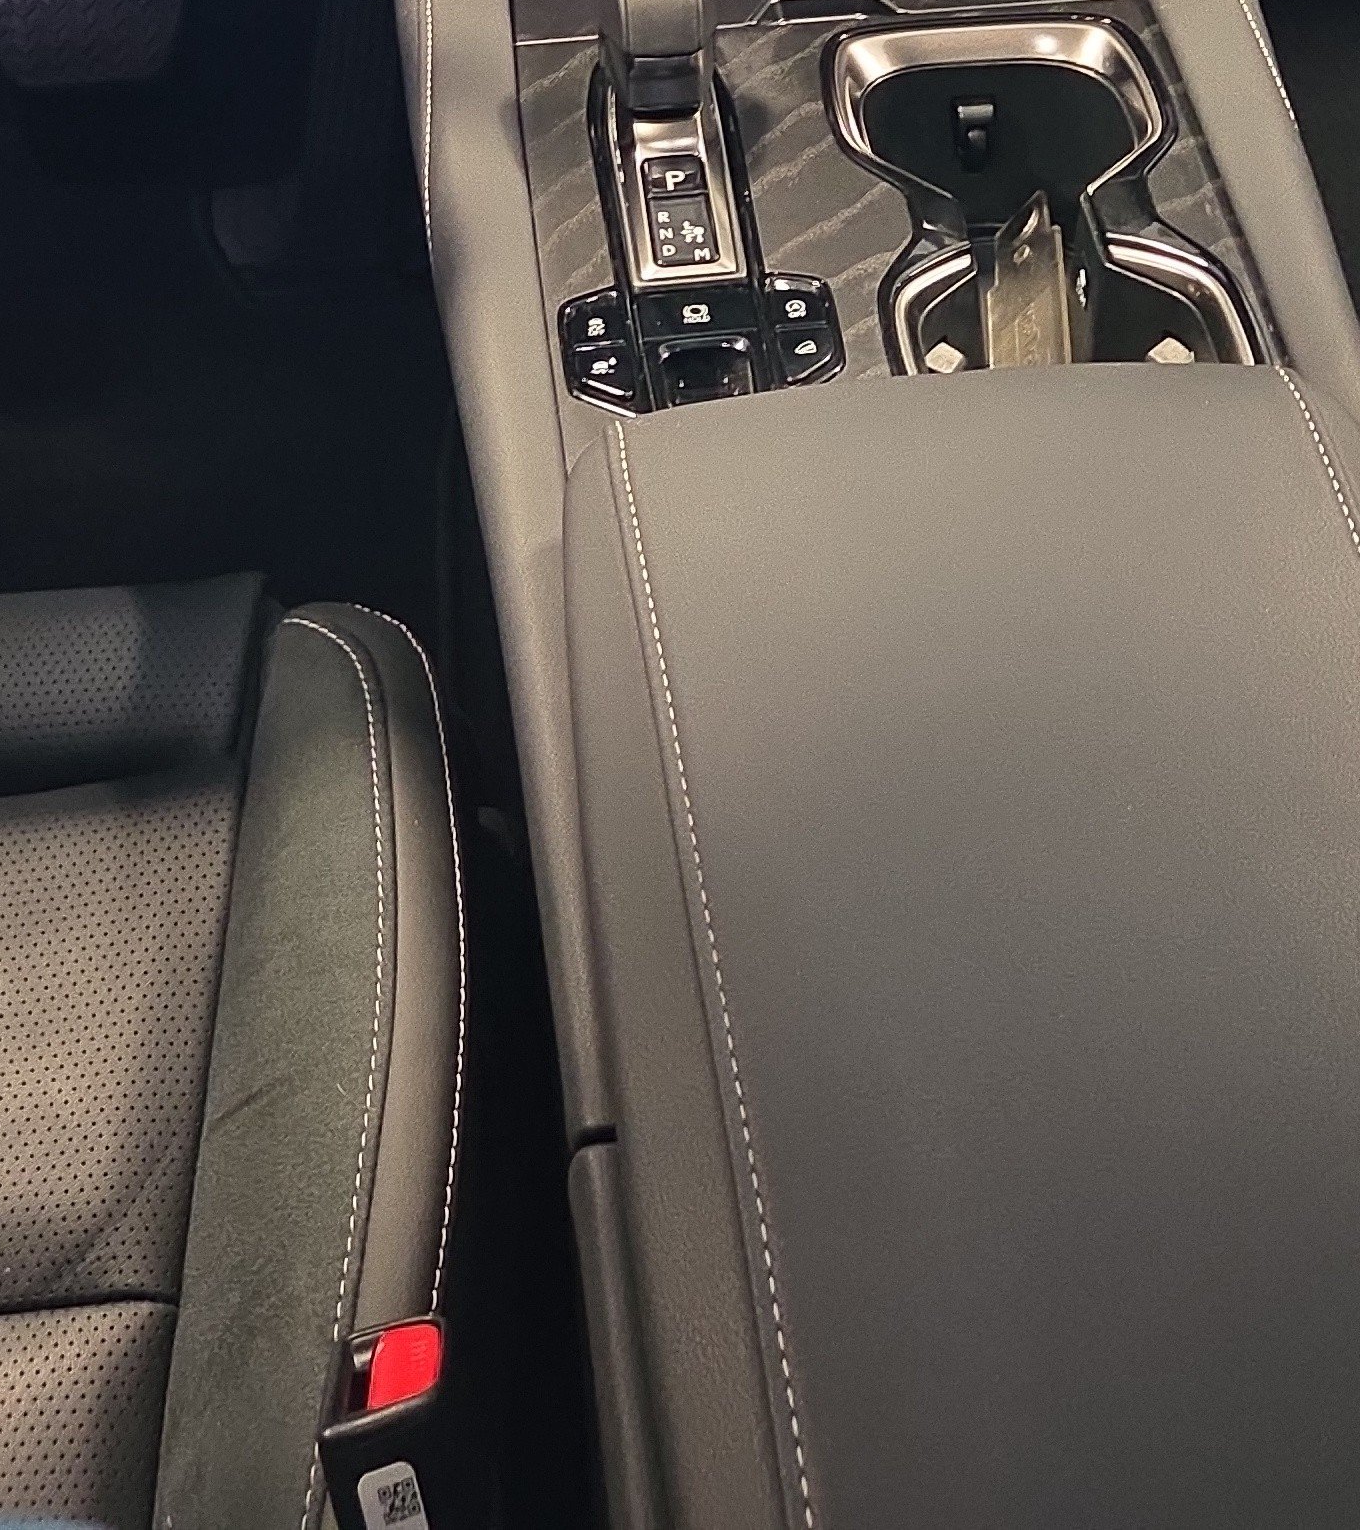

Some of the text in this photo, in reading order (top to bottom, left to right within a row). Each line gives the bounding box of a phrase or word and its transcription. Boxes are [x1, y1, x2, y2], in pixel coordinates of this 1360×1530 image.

[665, 170, 686, 191] P
[657, 211, 670, 223] R
[660, 227, 674, 240] N
[662, 244, 677, 257] D
[694, 247, 711, 262] M
